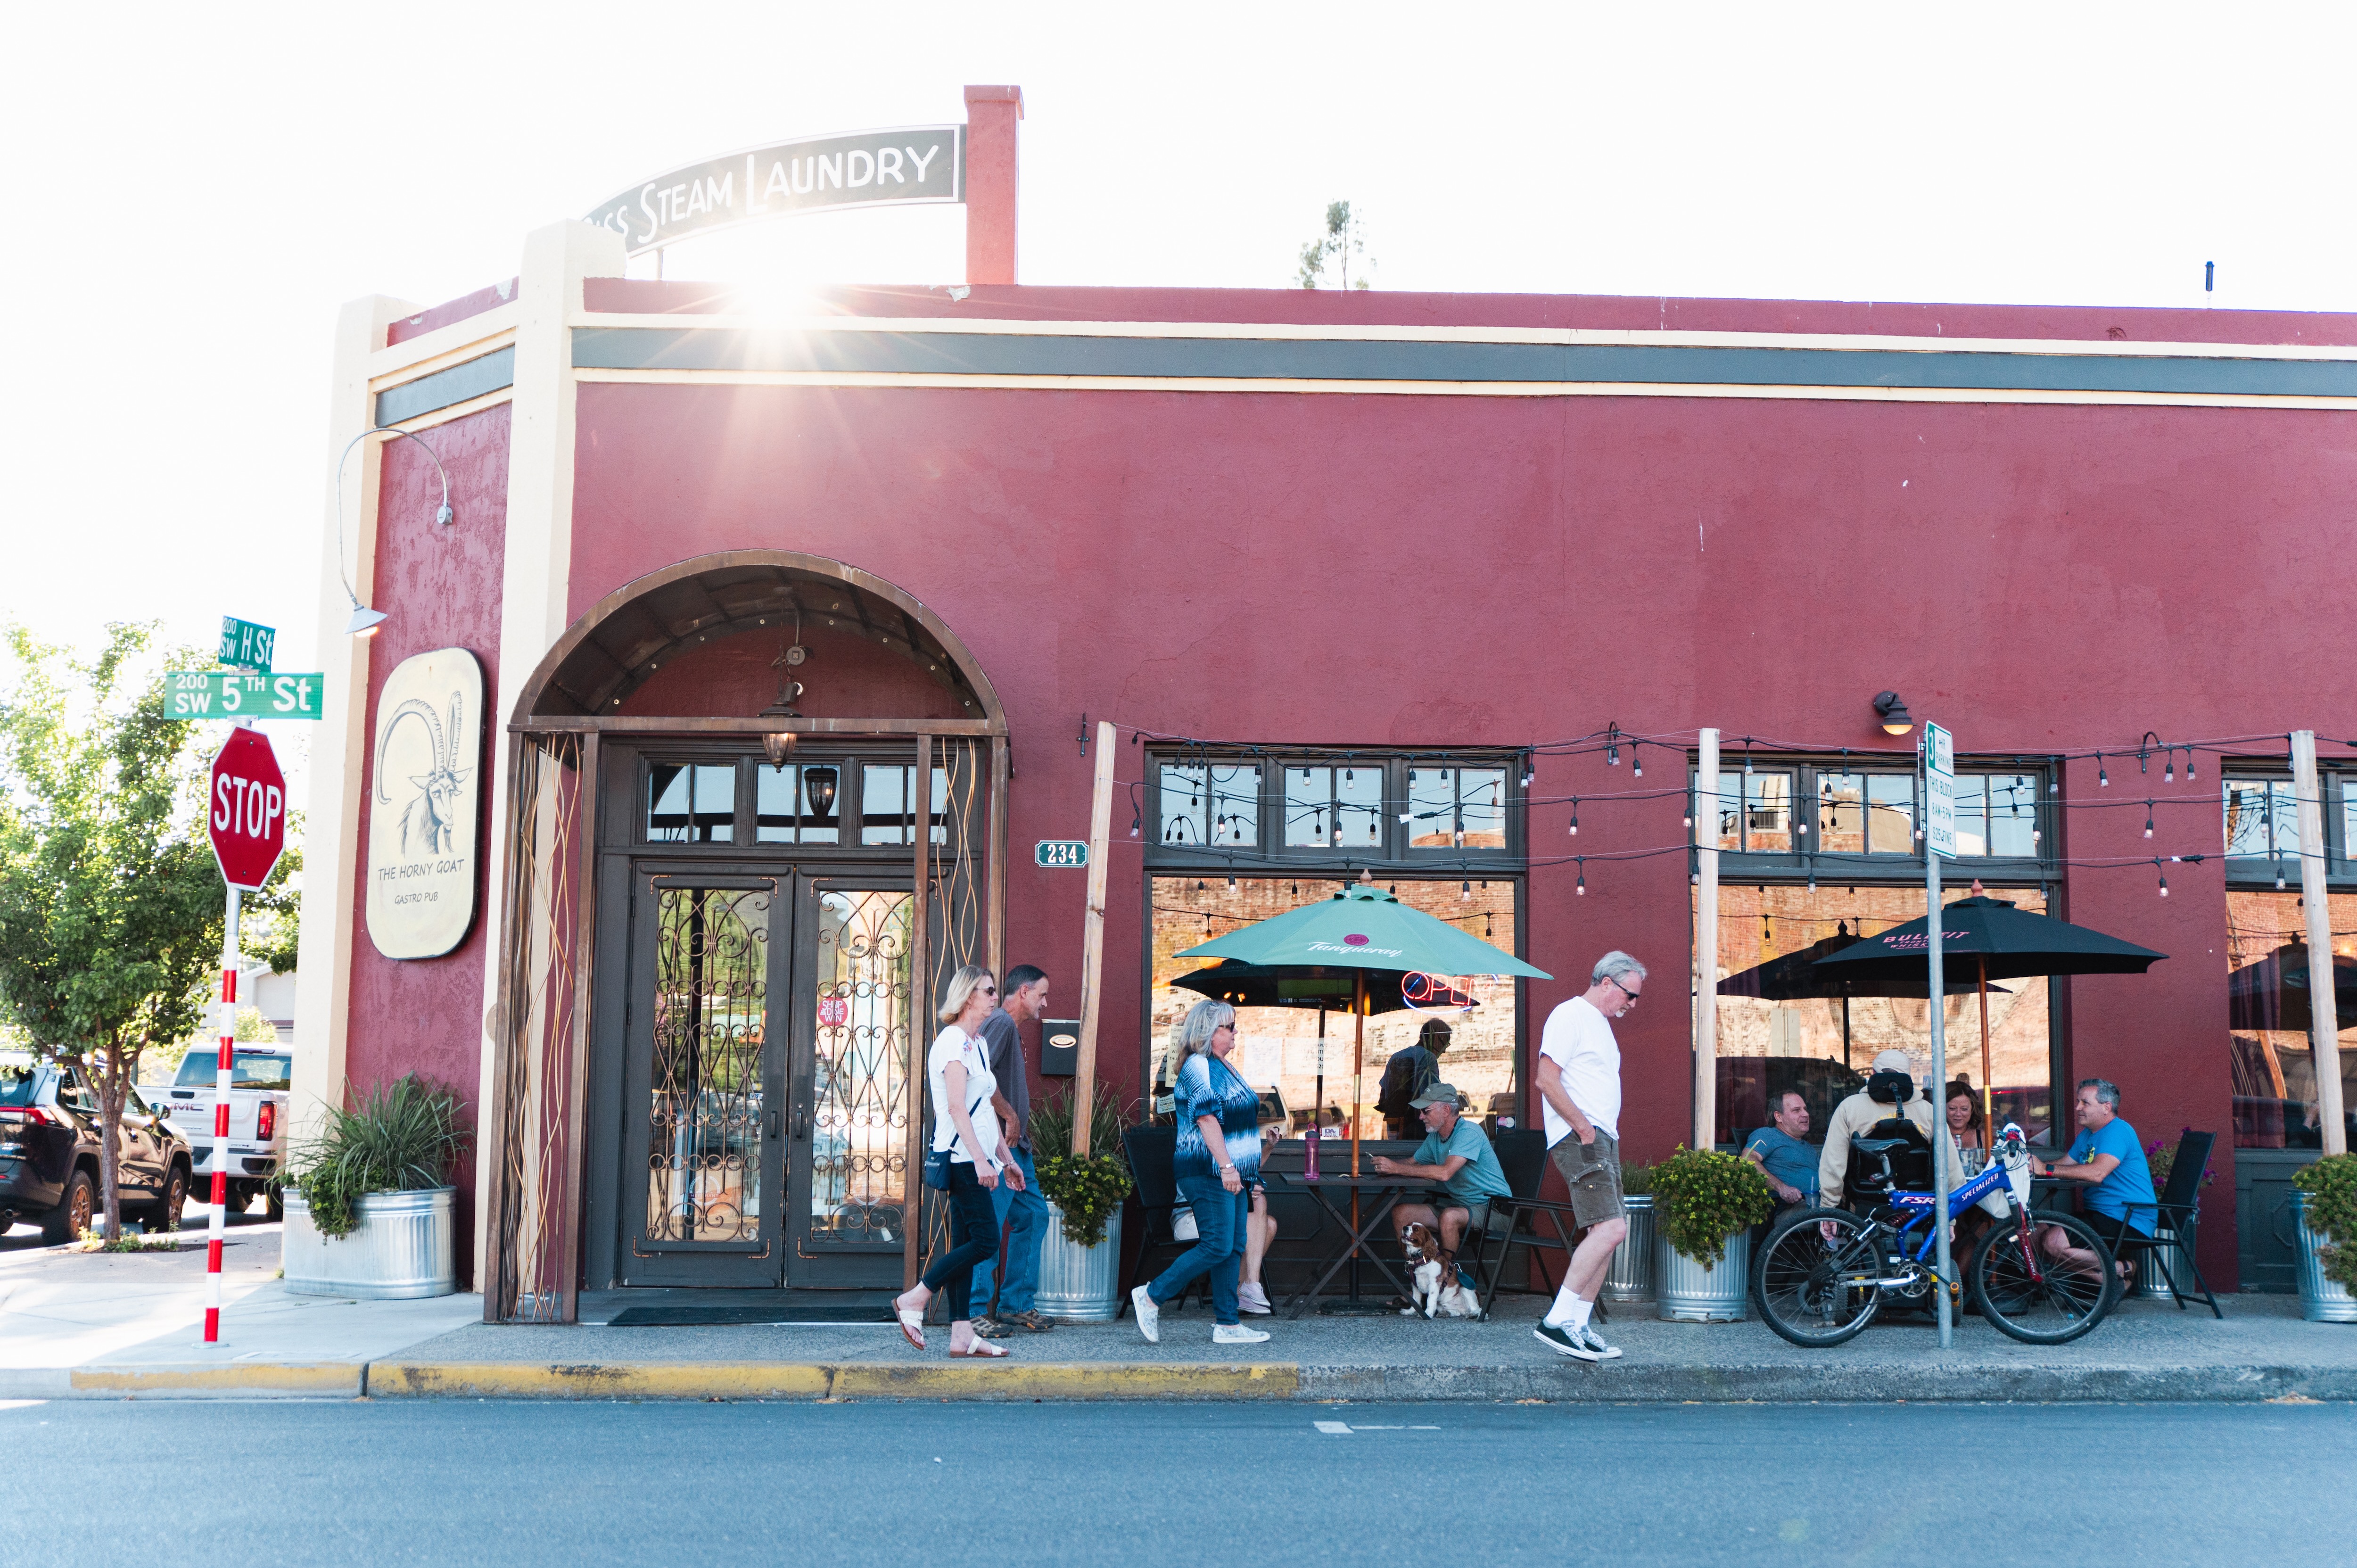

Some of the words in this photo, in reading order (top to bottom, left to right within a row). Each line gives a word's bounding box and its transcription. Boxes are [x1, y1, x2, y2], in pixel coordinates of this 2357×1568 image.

[637, 172, 732, 244] STEAM
[746, 145, 939, 215] LAUNDRY
[223, 617, 237, 635] 200
[219, 635, 236, 659] SW
[241, 627, 253, 661] H
[256, 630, 272, 666] St
[175, 675, 208, 689] 200
[175, 693, 211, 714] SW
[273, 677, 311, 712] St
[1929, 731, 1934, 761] 3
[1936, 751, 1952, 769] PARKING
[1930, 776, 1939, 792] THIS
[1940, 780, 1953, 799] BLOCK
[214, 773, 282, 841] STOP
[1943, 830, 1952, 845] FINE
[1047, 844, 1077, 864] 234
[378, 867, 396, 881] THE
[399, 862, 433, 879] HORNY
[437, 858, 464, 875] GOAT
[395, 893, 422, 905] GASTRO
[424, 891, 438, 902] PUB
[1307, 941, 1403, 957] Tanqueray
[1401, 971, 1492, 1007] OPEN
[1961, 1172, 1999, 1202] SPECIALIZED
[1899, 1196, 1936, 1205] FSR
